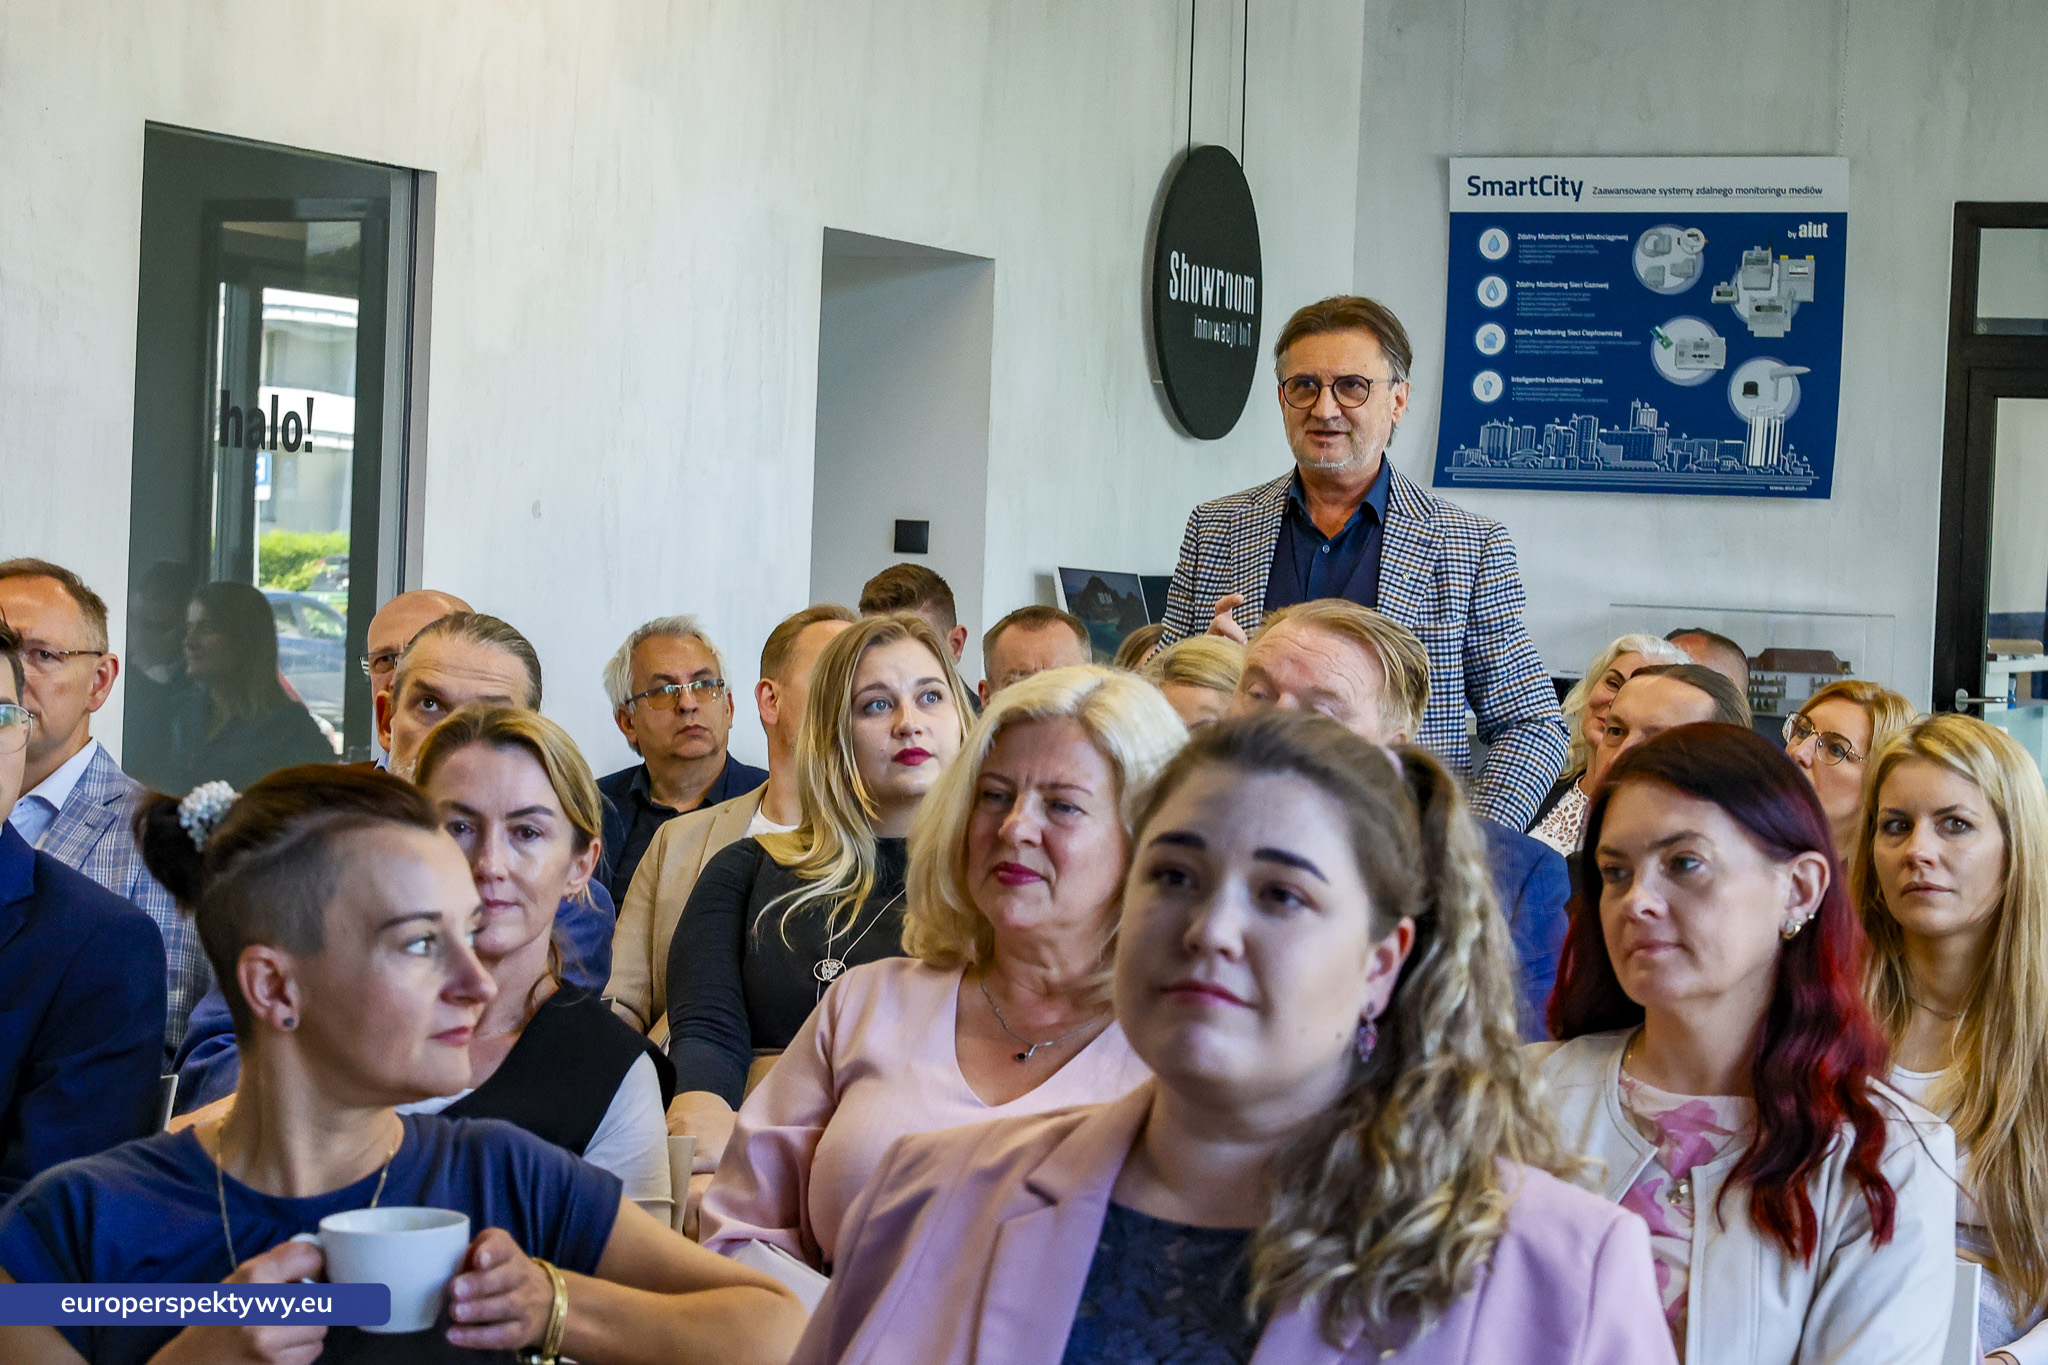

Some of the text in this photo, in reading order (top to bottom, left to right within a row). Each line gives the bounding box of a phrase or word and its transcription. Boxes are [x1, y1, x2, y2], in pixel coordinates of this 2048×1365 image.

[1467, 175, 1584, 202] SmartCity
[1592, 186, 1823, 198] Zaawansowane systemy zdalnego monitoringu mediów
[1537, 233, 1570, 242] Monitoring
[1787, 221, 1829, 240] by aiut
[1169, 250, 1255, 315] Showroom
[1536, 281, 1569, 290] Monitoring
[1534, 329, 1567, 338] Monitoring
[220, 389, 315, 454] halo!
